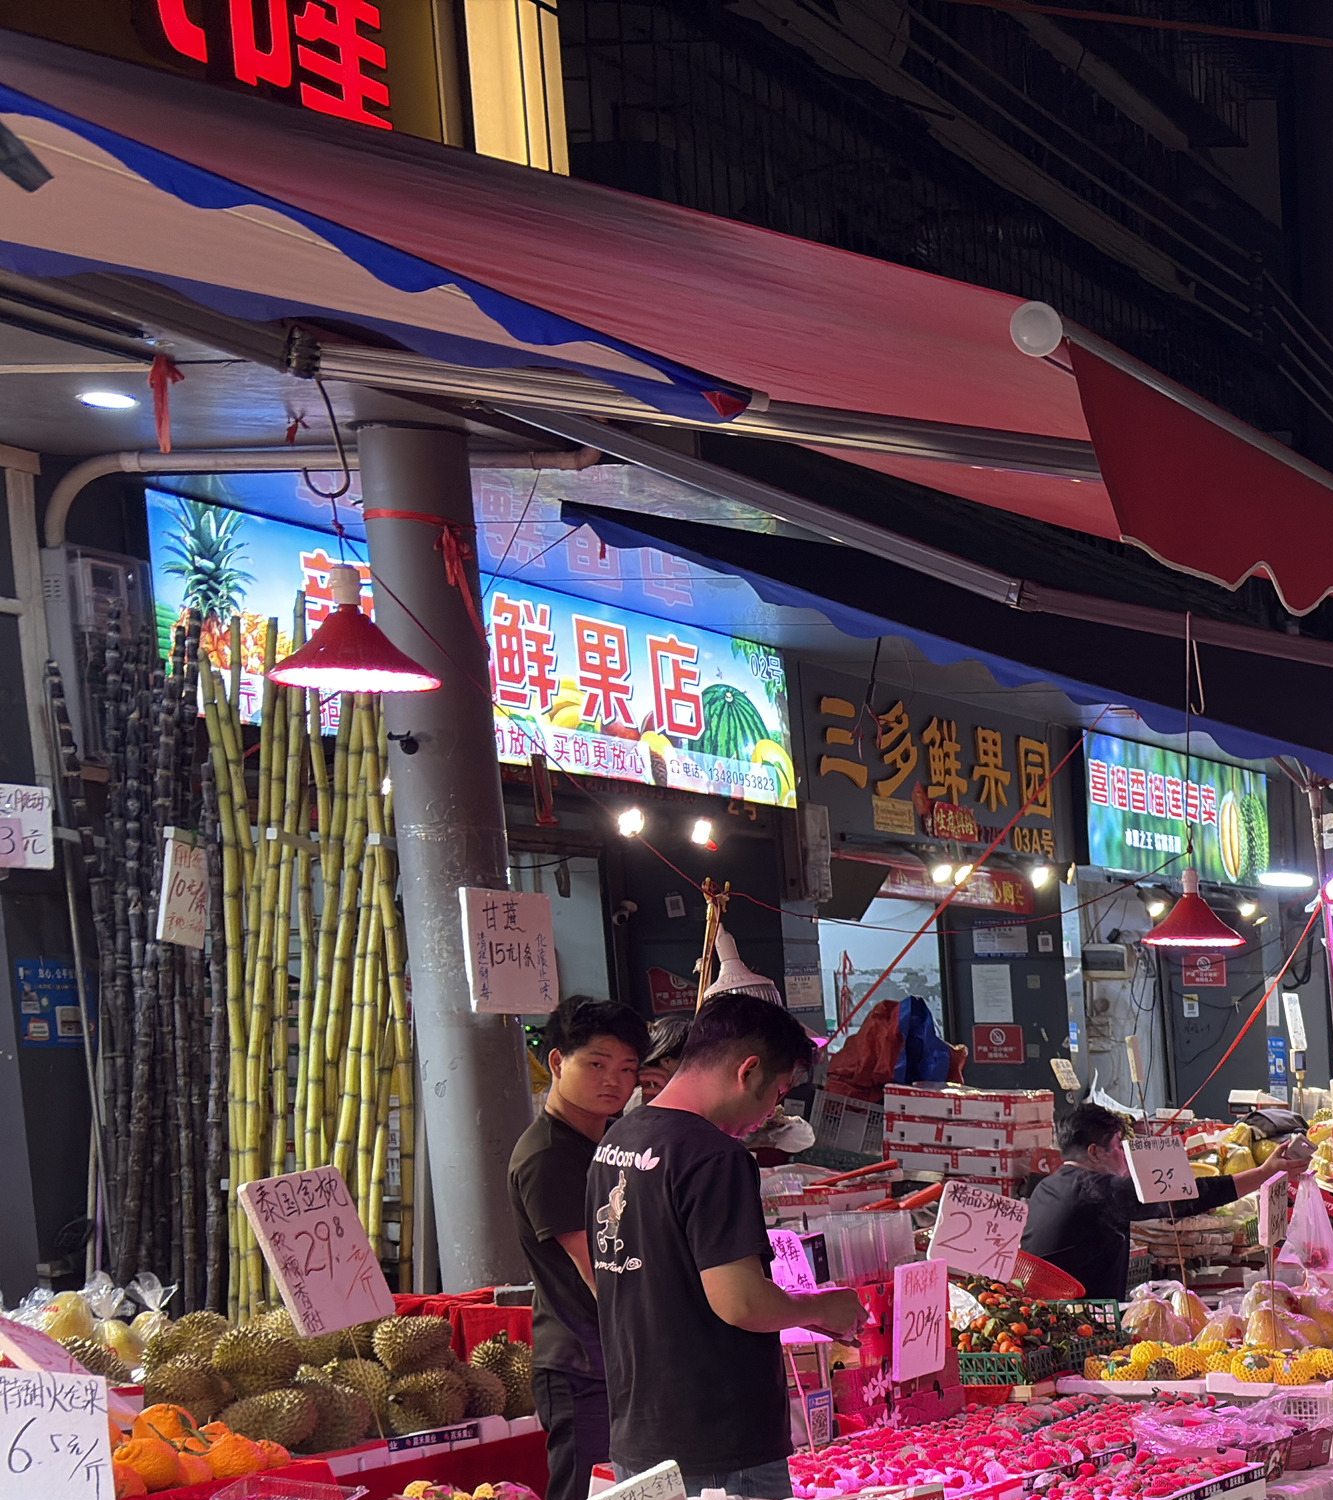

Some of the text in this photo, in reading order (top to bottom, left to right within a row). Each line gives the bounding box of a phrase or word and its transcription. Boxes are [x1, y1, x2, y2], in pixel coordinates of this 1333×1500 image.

[750, 653, 783, 685] 02号
[553, 734, 646, 776] 买的更放心
[820, 696, 1051, 818] 三多鲜果园
[708, 767, 776, 792] 13480953823
[1088, 758, 1218, 827] 喜榴香榴莲专卖
[1013, 826, 1055, 857] 03A号
[482, 899, 526, 933] 甘蔗
